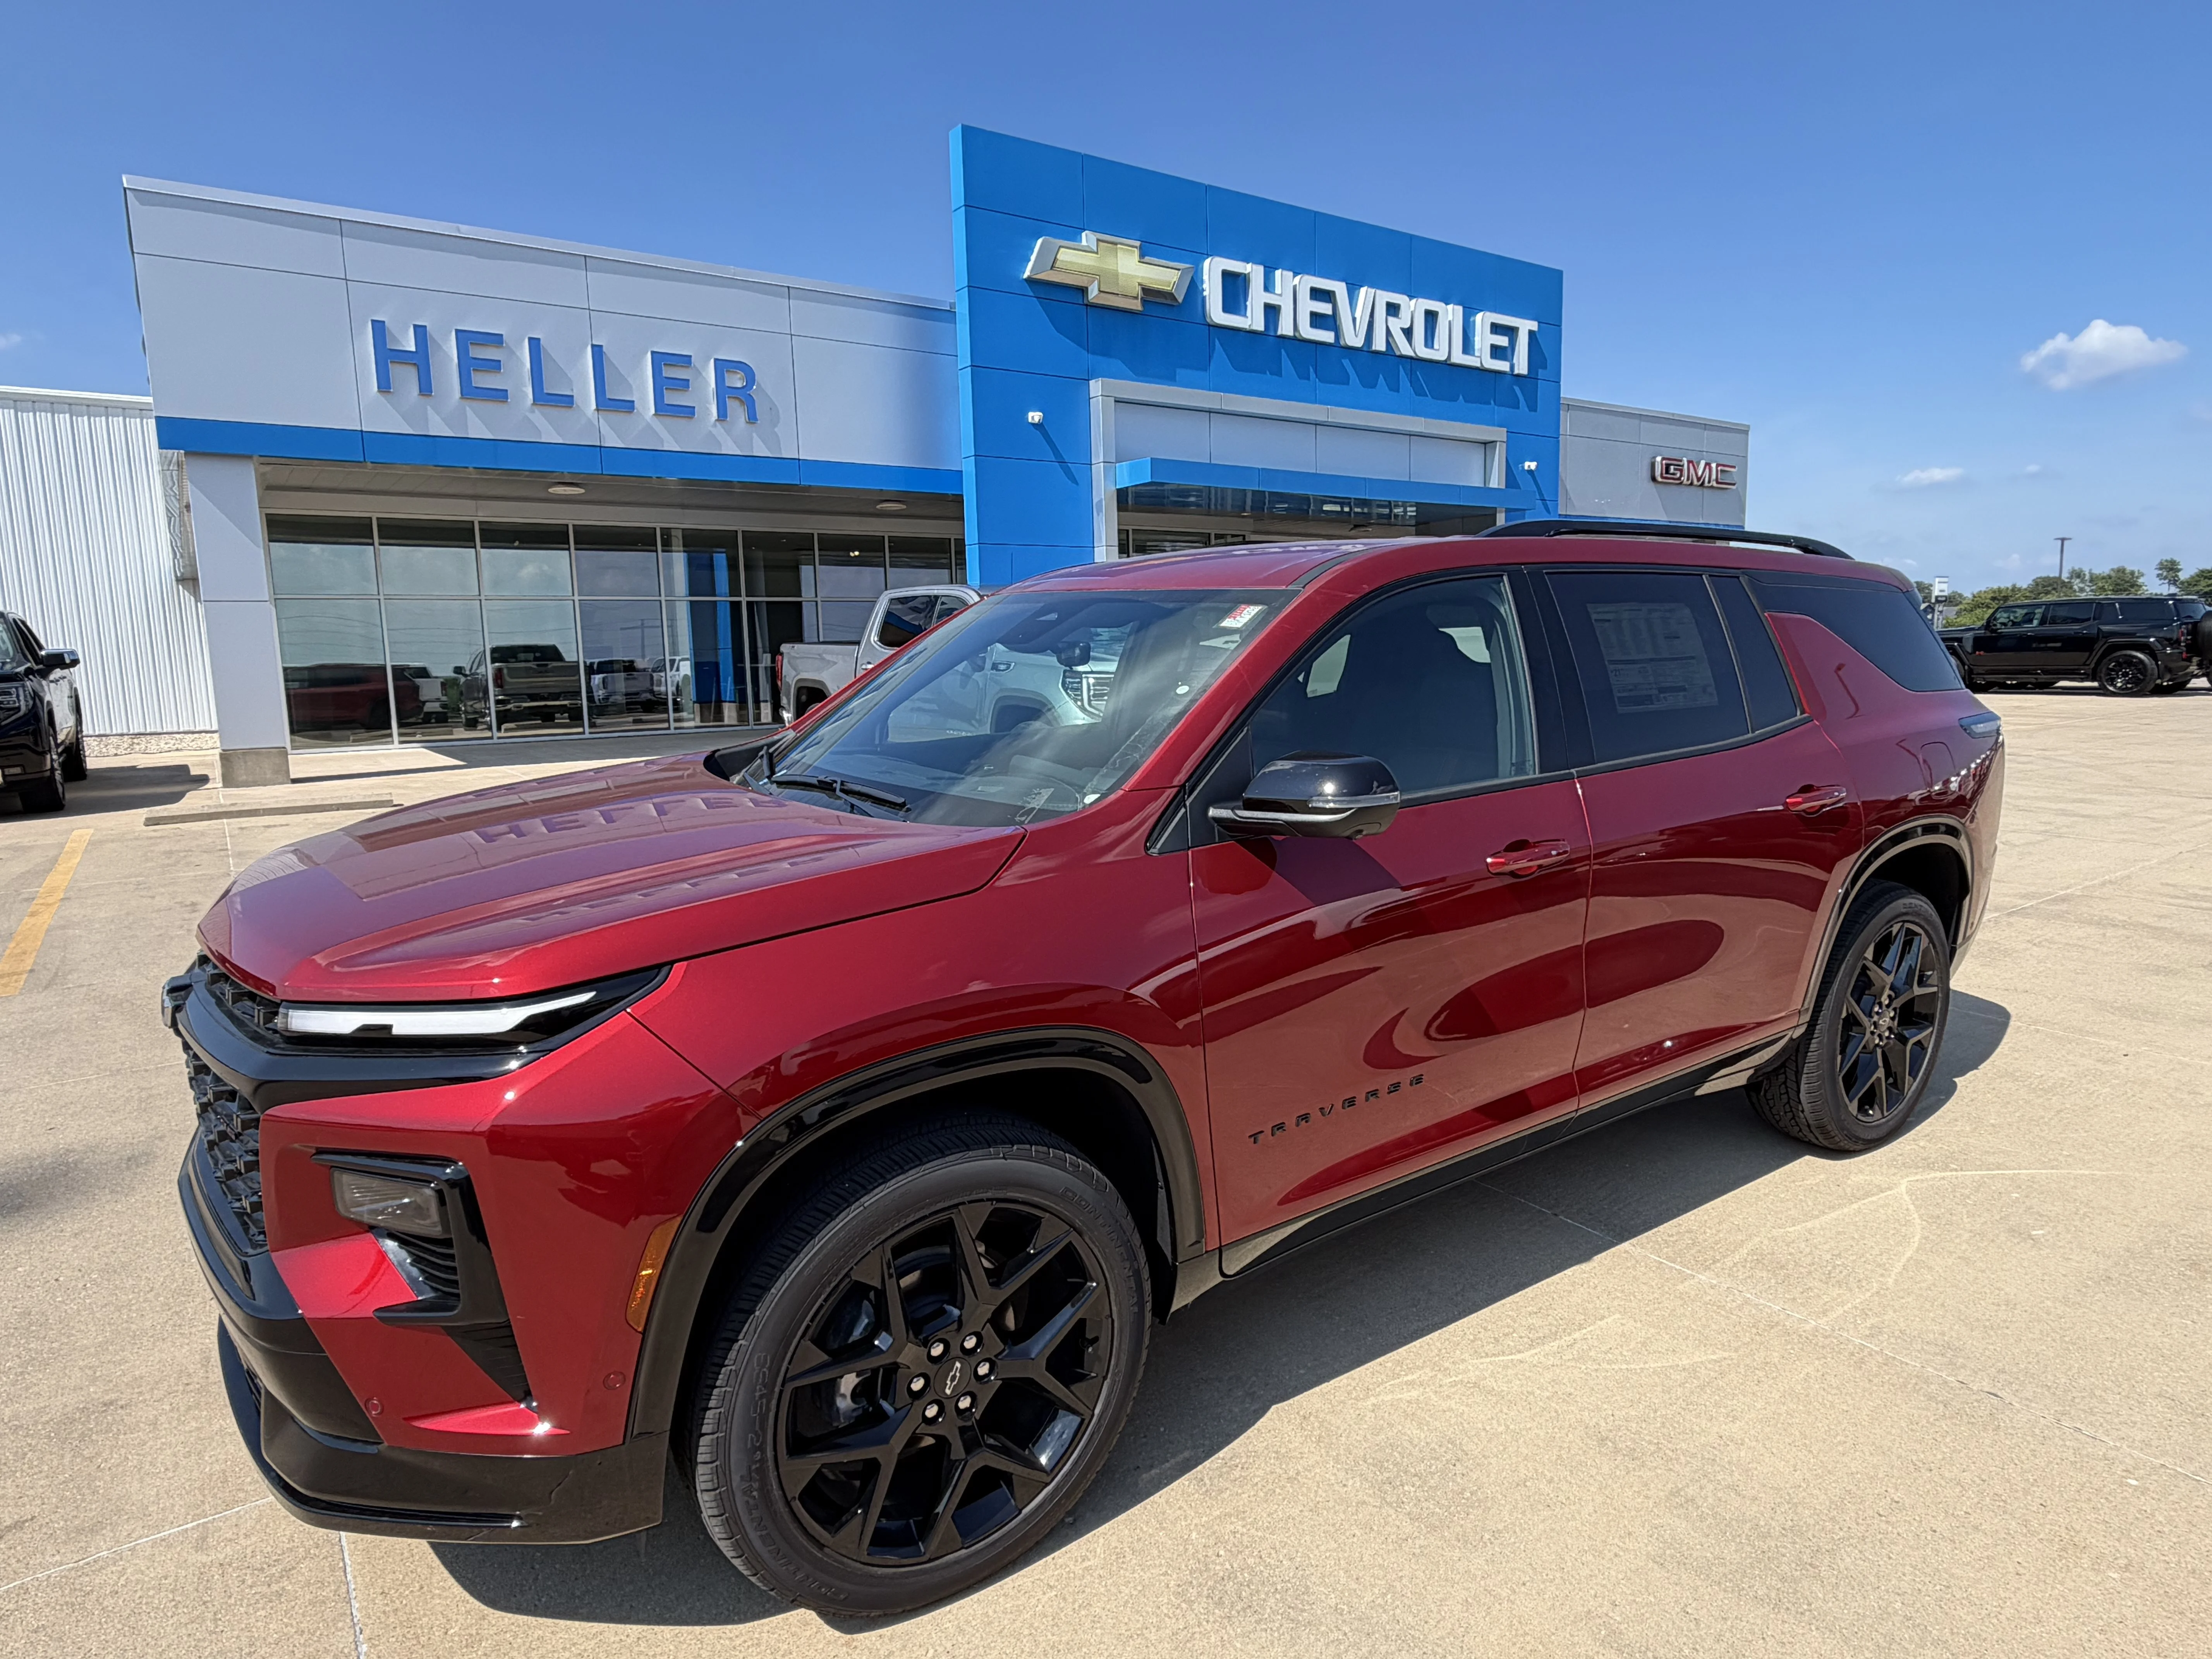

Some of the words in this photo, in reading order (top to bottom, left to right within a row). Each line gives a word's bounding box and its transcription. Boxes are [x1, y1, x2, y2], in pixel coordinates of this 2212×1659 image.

[371, 319, 759, 423] HELLER
[1203, 256, 1539, 376] CHEVROLET
[1651, 456, 1738, 489] GMC
[1248, 1073, 1424, 1145] TRAVERSE
[1059, 1186, 1140, 1322] CONTINENTAL
[739, 1465, 849, 1601] CONTINENTAL
